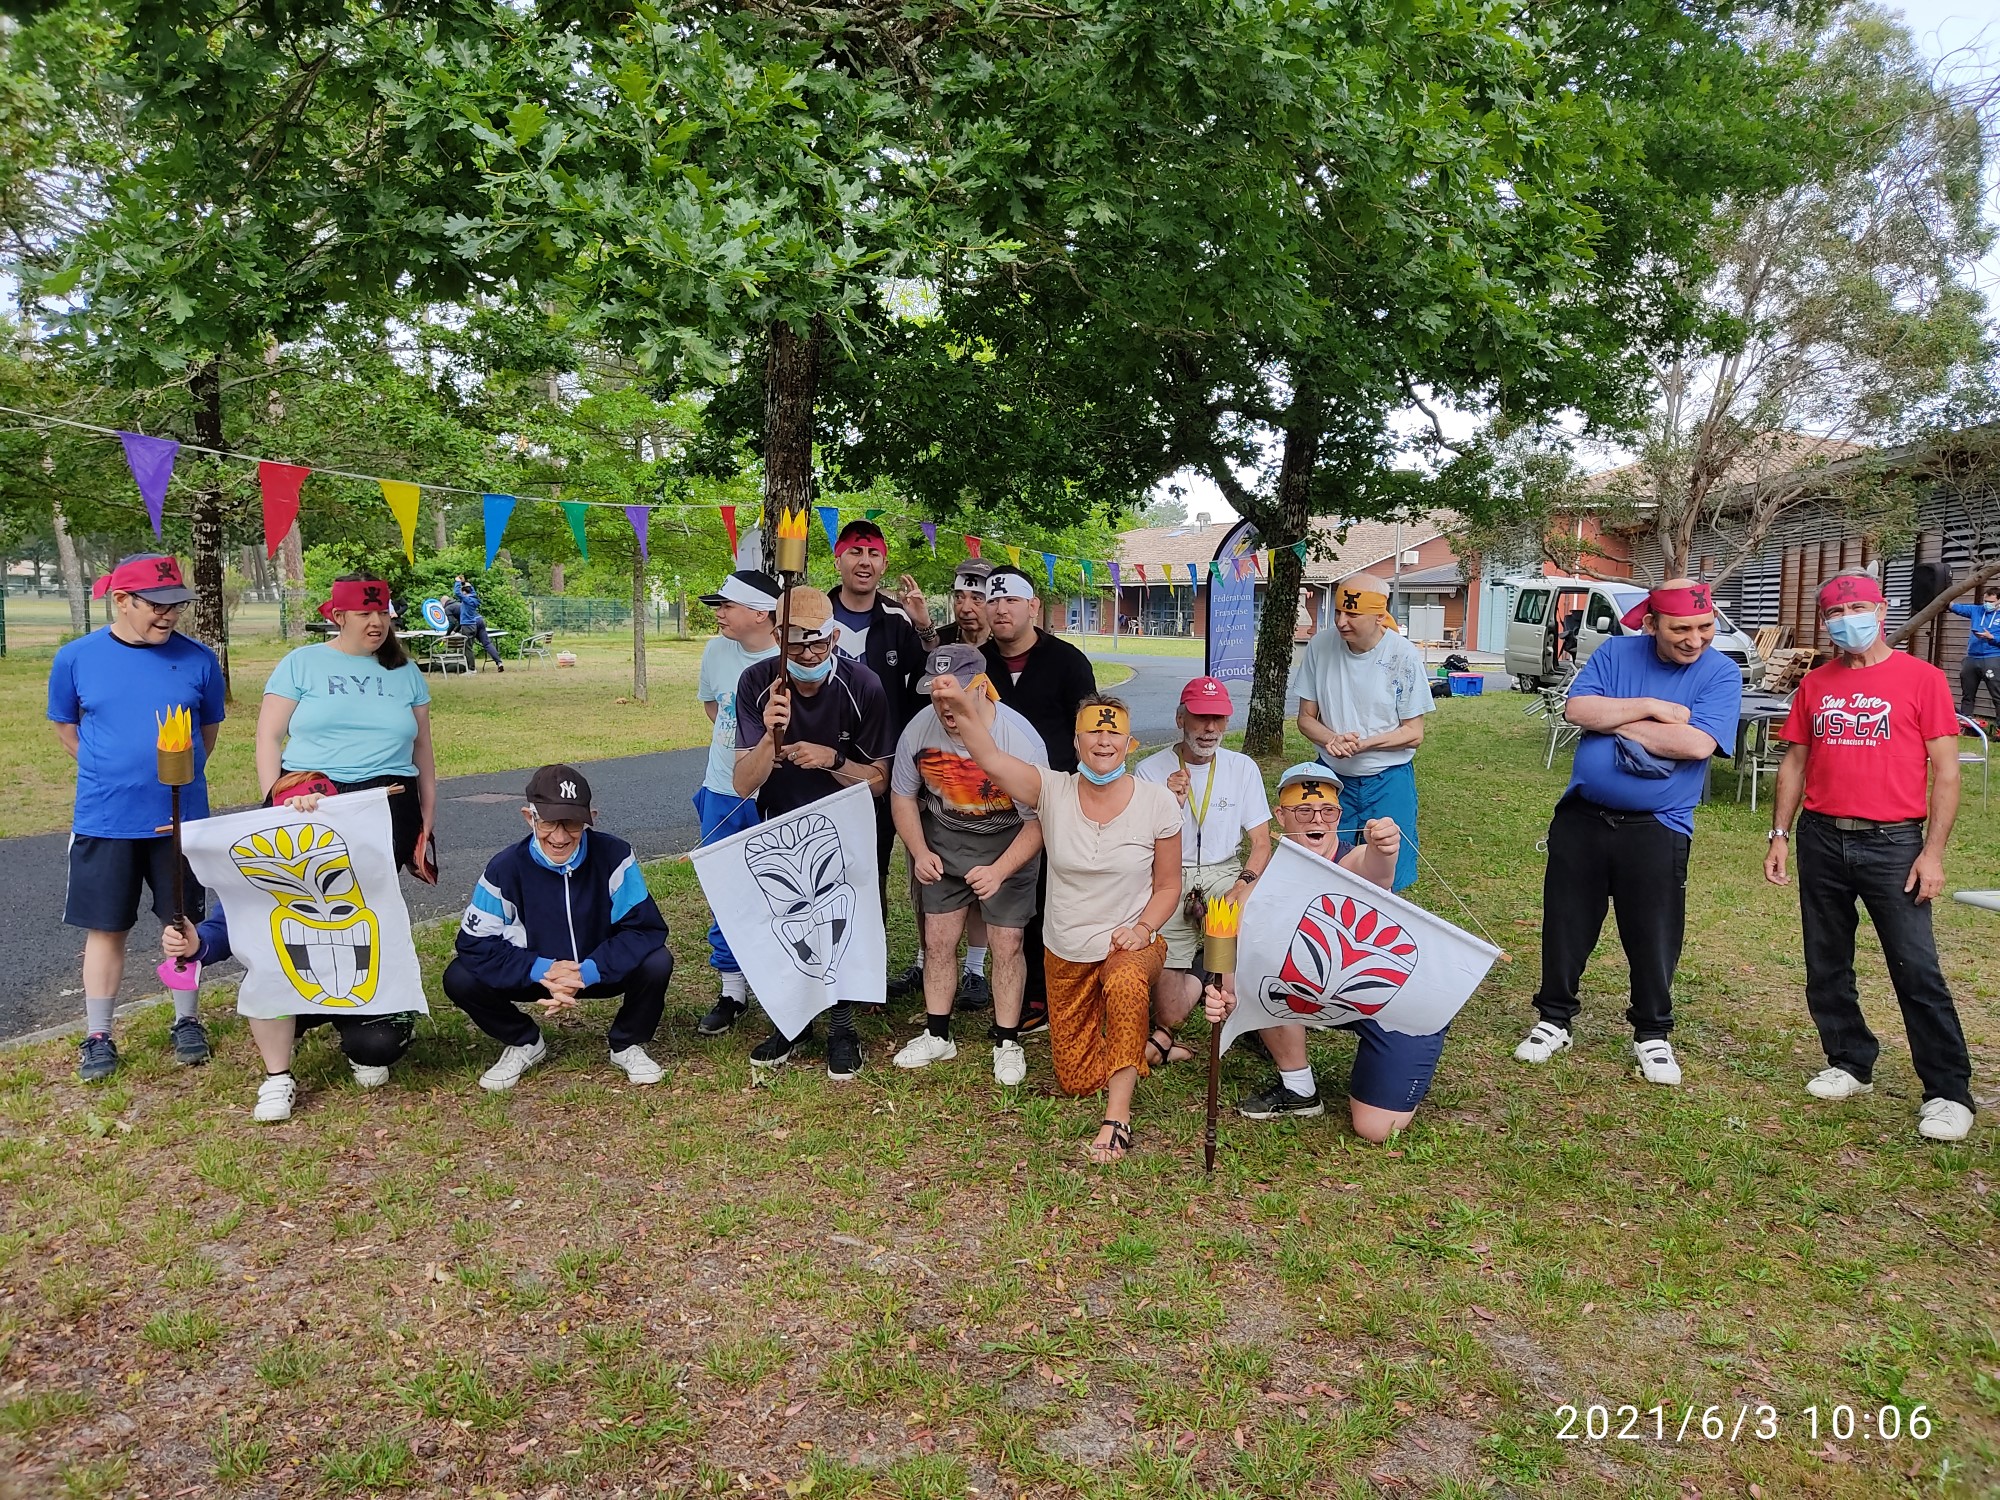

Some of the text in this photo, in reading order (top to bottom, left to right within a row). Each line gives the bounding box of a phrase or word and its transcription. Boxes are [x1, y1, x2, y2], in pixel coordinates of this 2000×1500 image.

[1213, 594, 1251, 603] Fédération
[1214, 608, 1248, 617] Française
[1215, 624, 1247, 634] du Sport
[1218, 638, 1244, 647] Adapté
[1210, 664, 1254, 679] Gironde
[1820, 693, 1882, 710] San Jose
[1826, 737, 1877, 747] San Francisco Bay
[559, 780, 578, 799] NY
